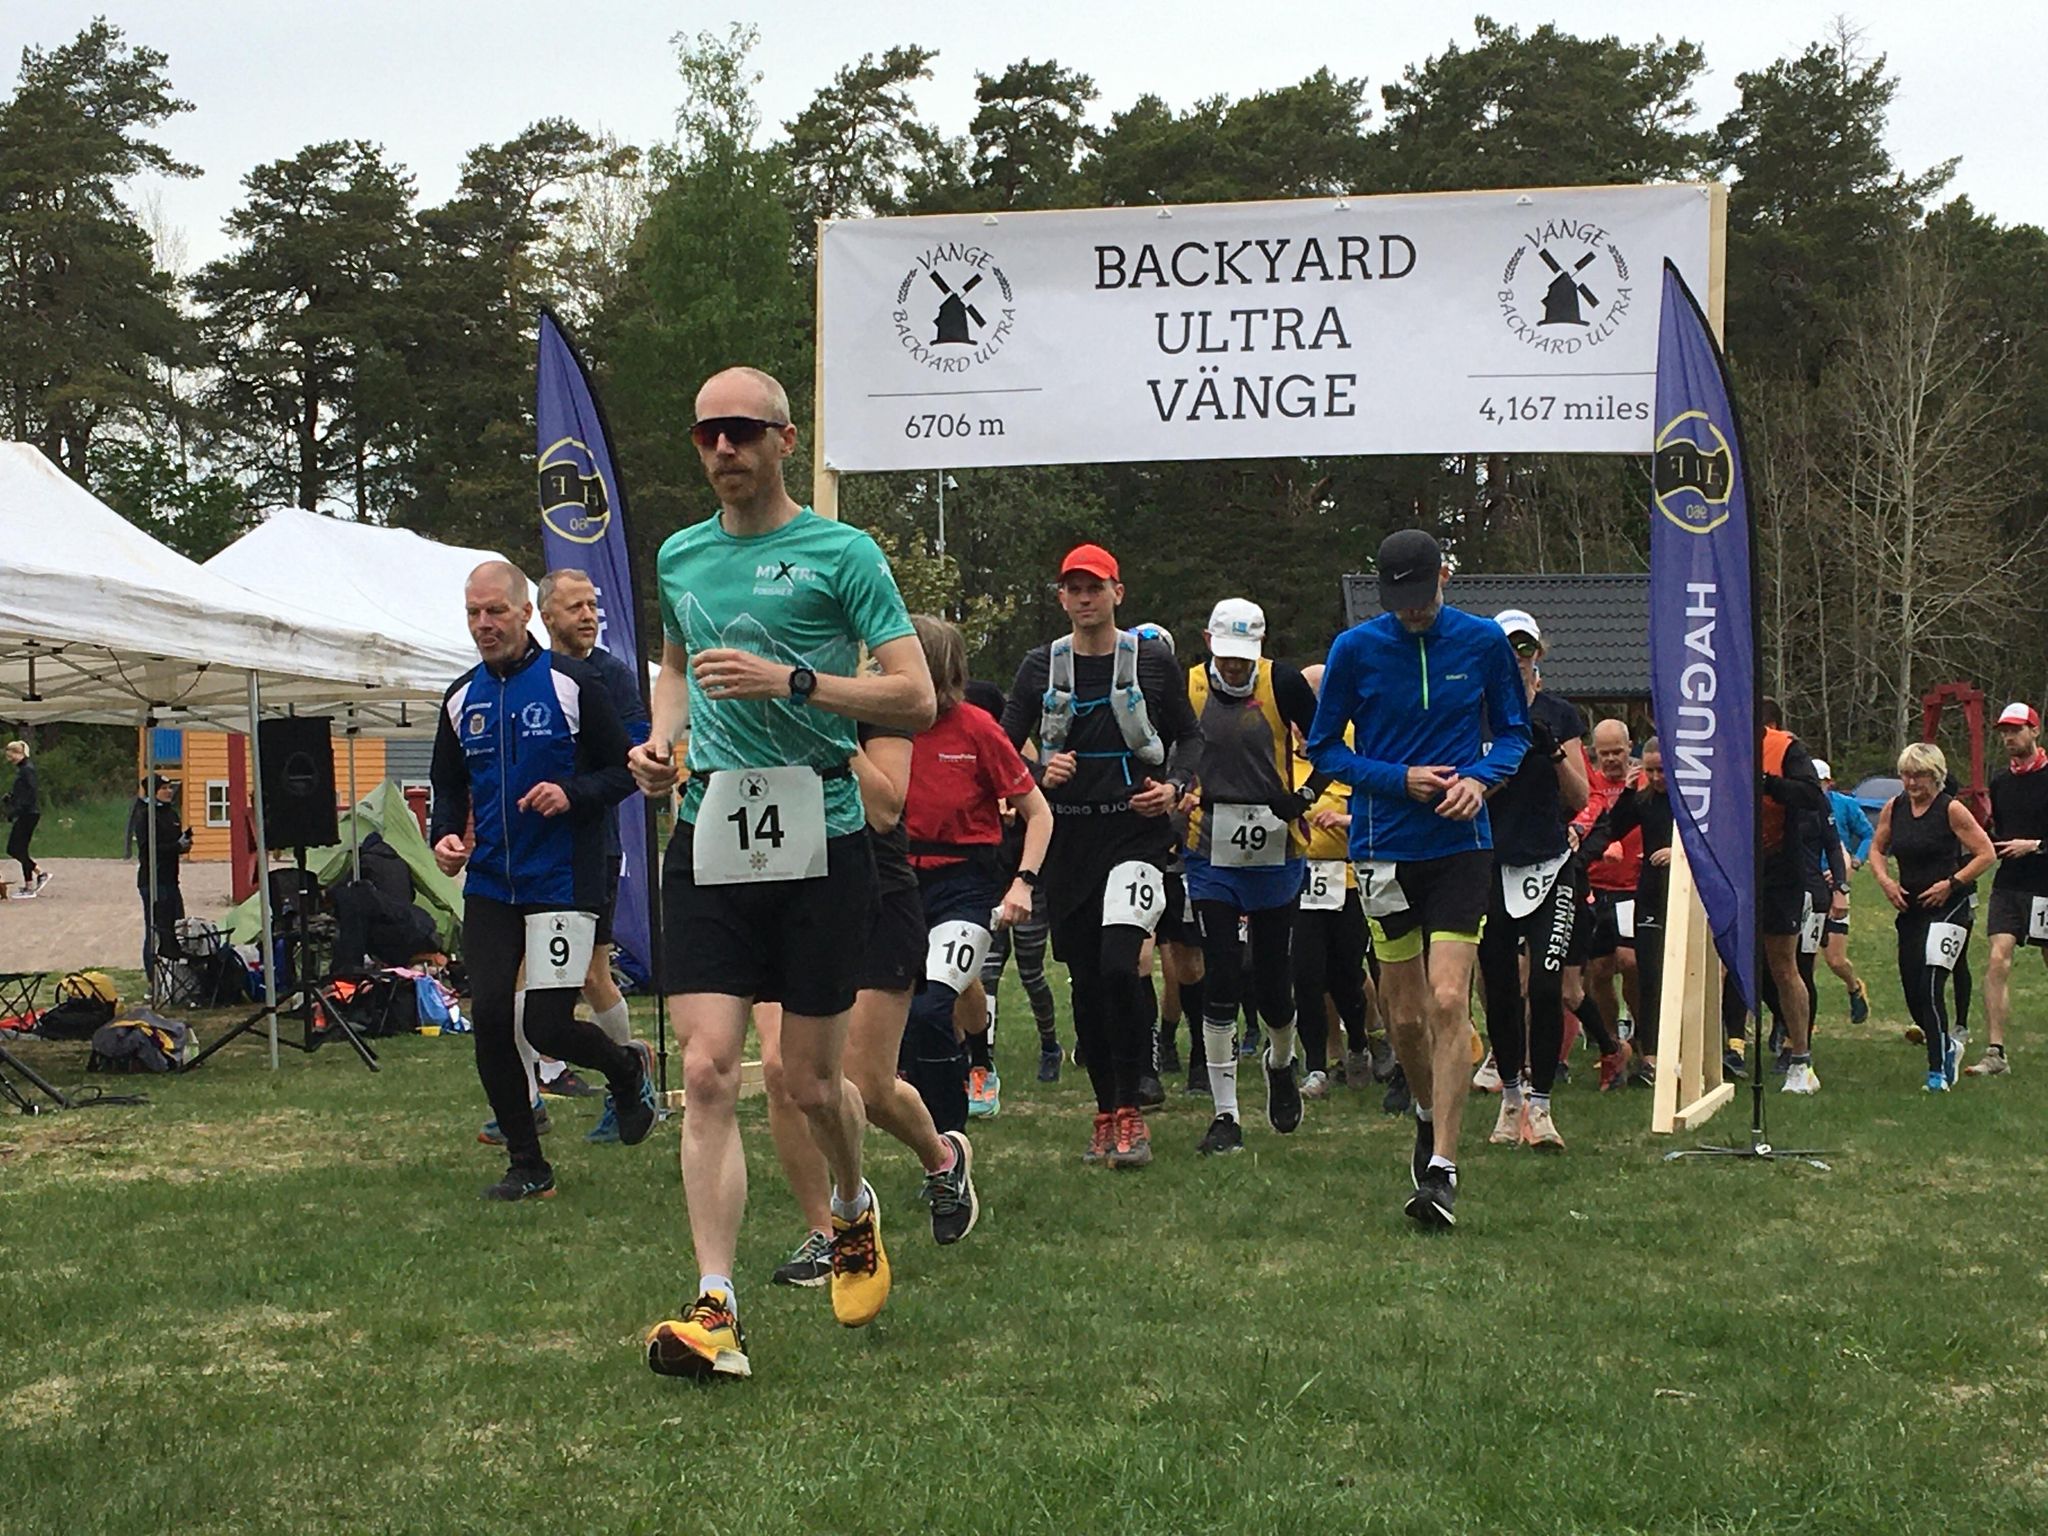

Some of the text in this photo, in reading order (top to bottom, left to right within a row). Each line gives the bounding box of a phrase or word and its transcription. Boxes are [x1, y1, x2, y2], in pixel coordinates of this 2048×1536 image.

[1094, 234, 1417, 290] BACKYARD
[1155, 306, 1352, 354] ULTRA
[1498, 286, 1633, 355] BACKYARD ULTRA
[892, 307, 1017, 373] BACKYARD ULTRA
[1147, 365, 1357, 422] VÄNGE
[1479, 395, 1649, 425] 4,167 miles
[905, 413, 1005, 439] 6706 m
[1056, 800, 1132, 816] BORG BJO
[727, 804, 785, 851] 14
[1230, 825, 1267, 851] 49
[1125, 882, 1154, 911] 19
[1358, 868, 1375, 897] 7
[1544, 884, 1574, 972] RUNNERS
[2036, 911, 2048, 927] 1
[549, 936, 570, 967] 9
[942, 940, 975, 974] 10
[1940, 937, 1960, 958] 63
